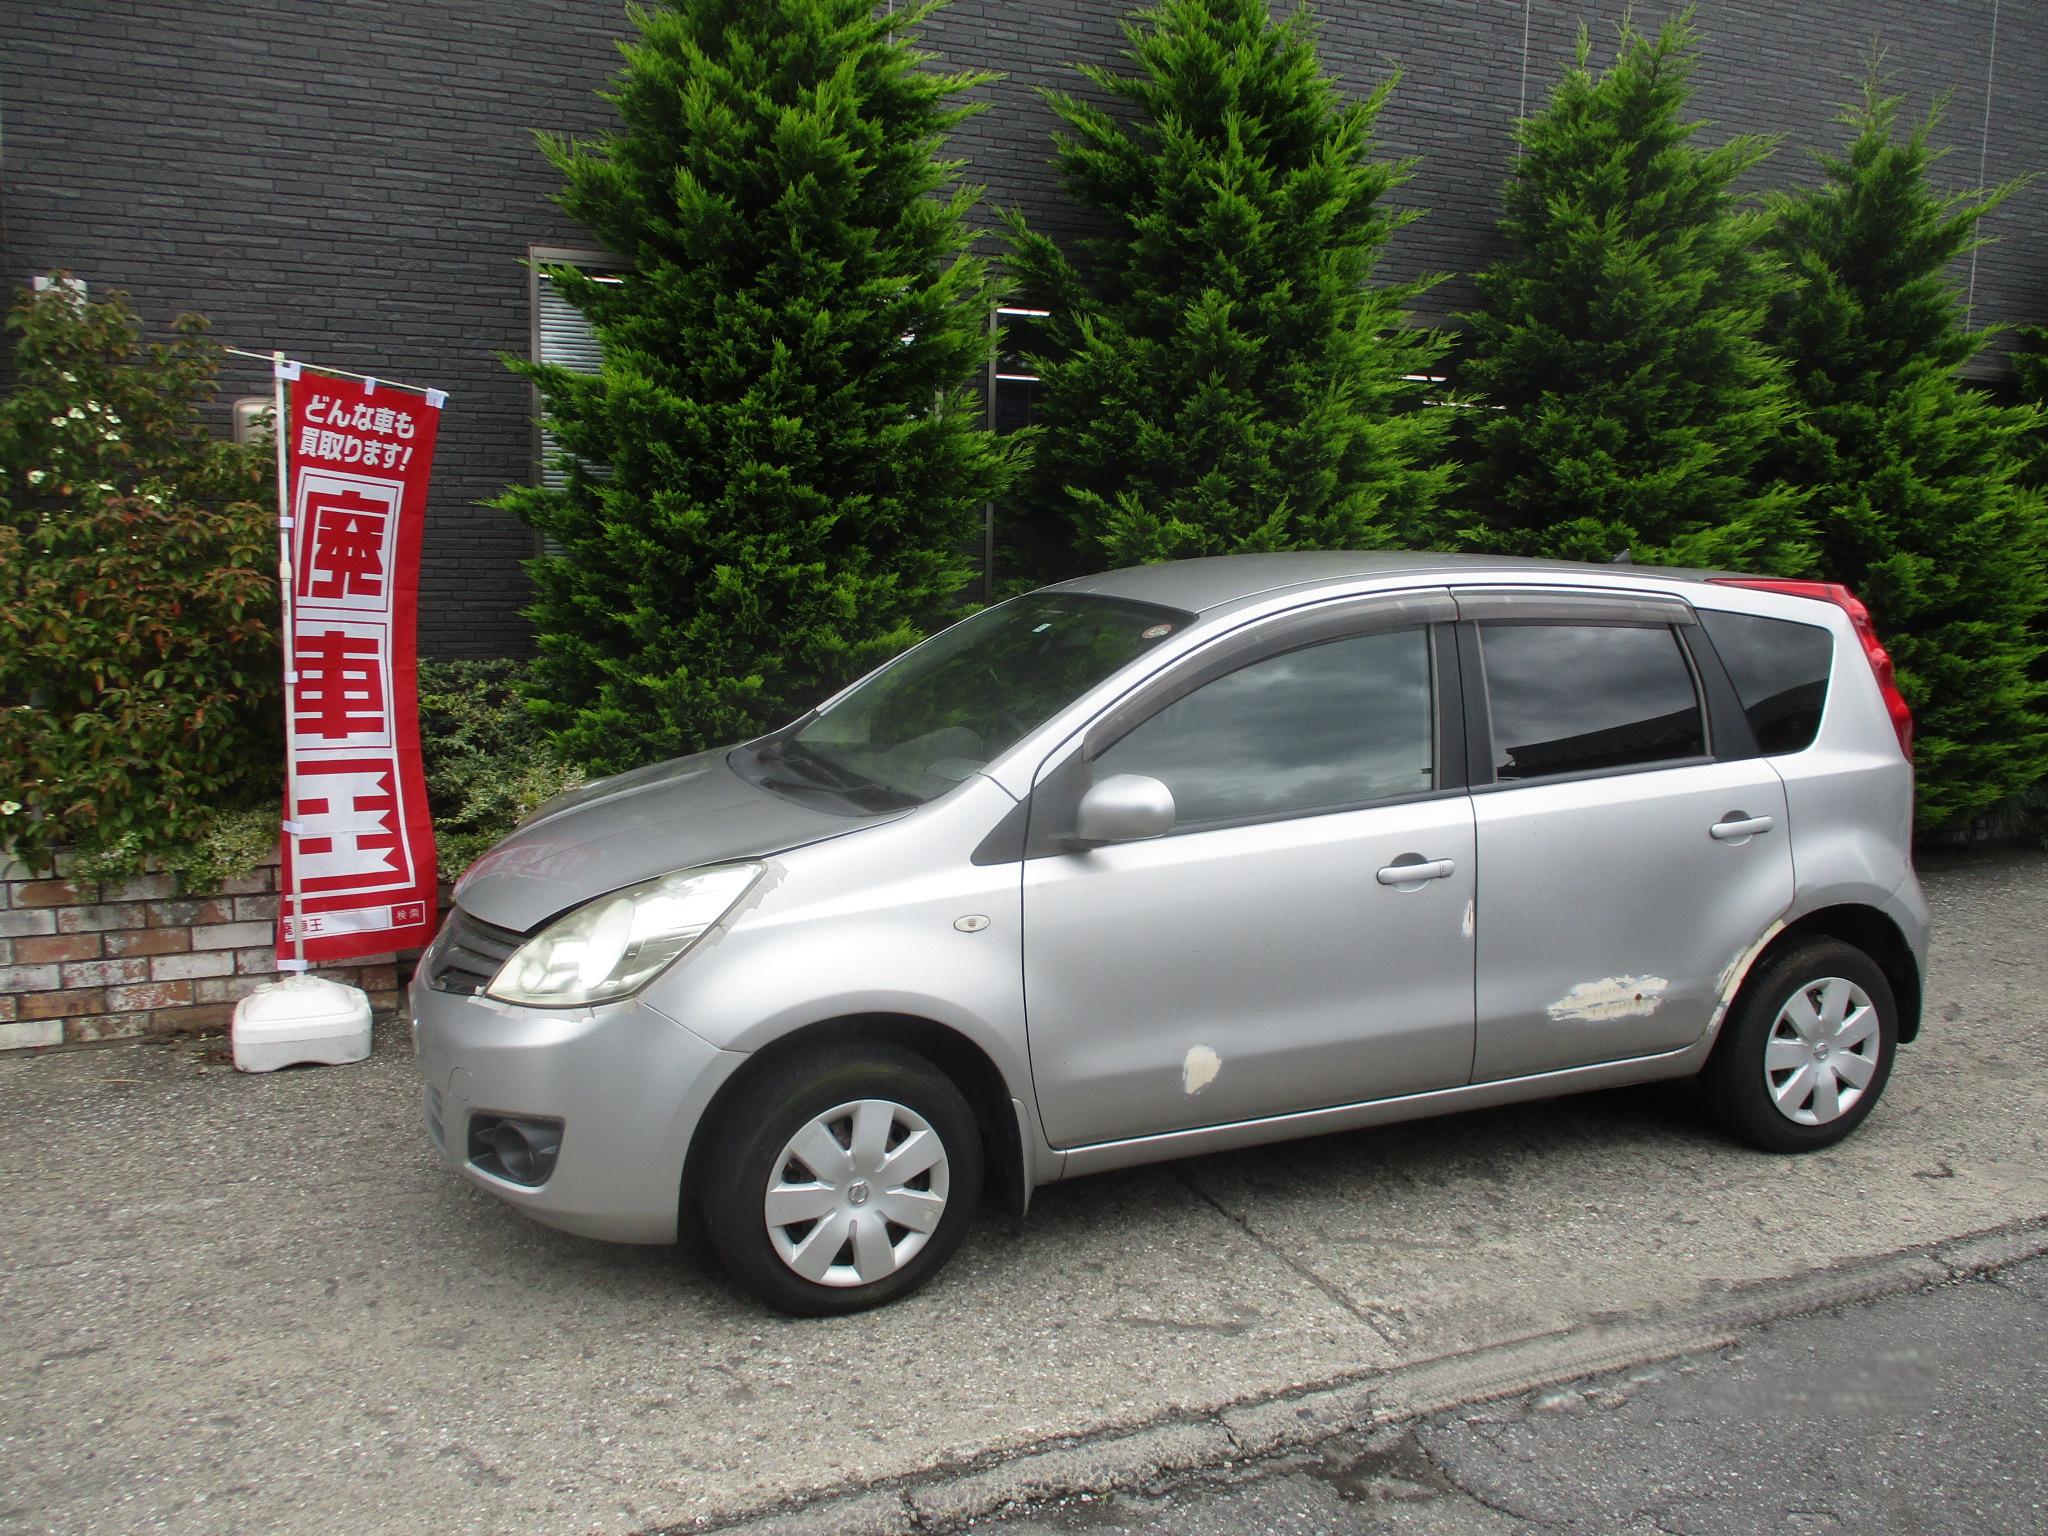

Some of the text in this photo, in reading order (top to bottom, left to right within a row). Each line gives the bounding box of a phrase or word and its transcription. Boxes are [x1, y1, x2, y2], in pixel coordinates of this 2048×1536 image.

[305, 394, 415, 439] どんな車も
[294, 489, 400, 881] 廃車王
